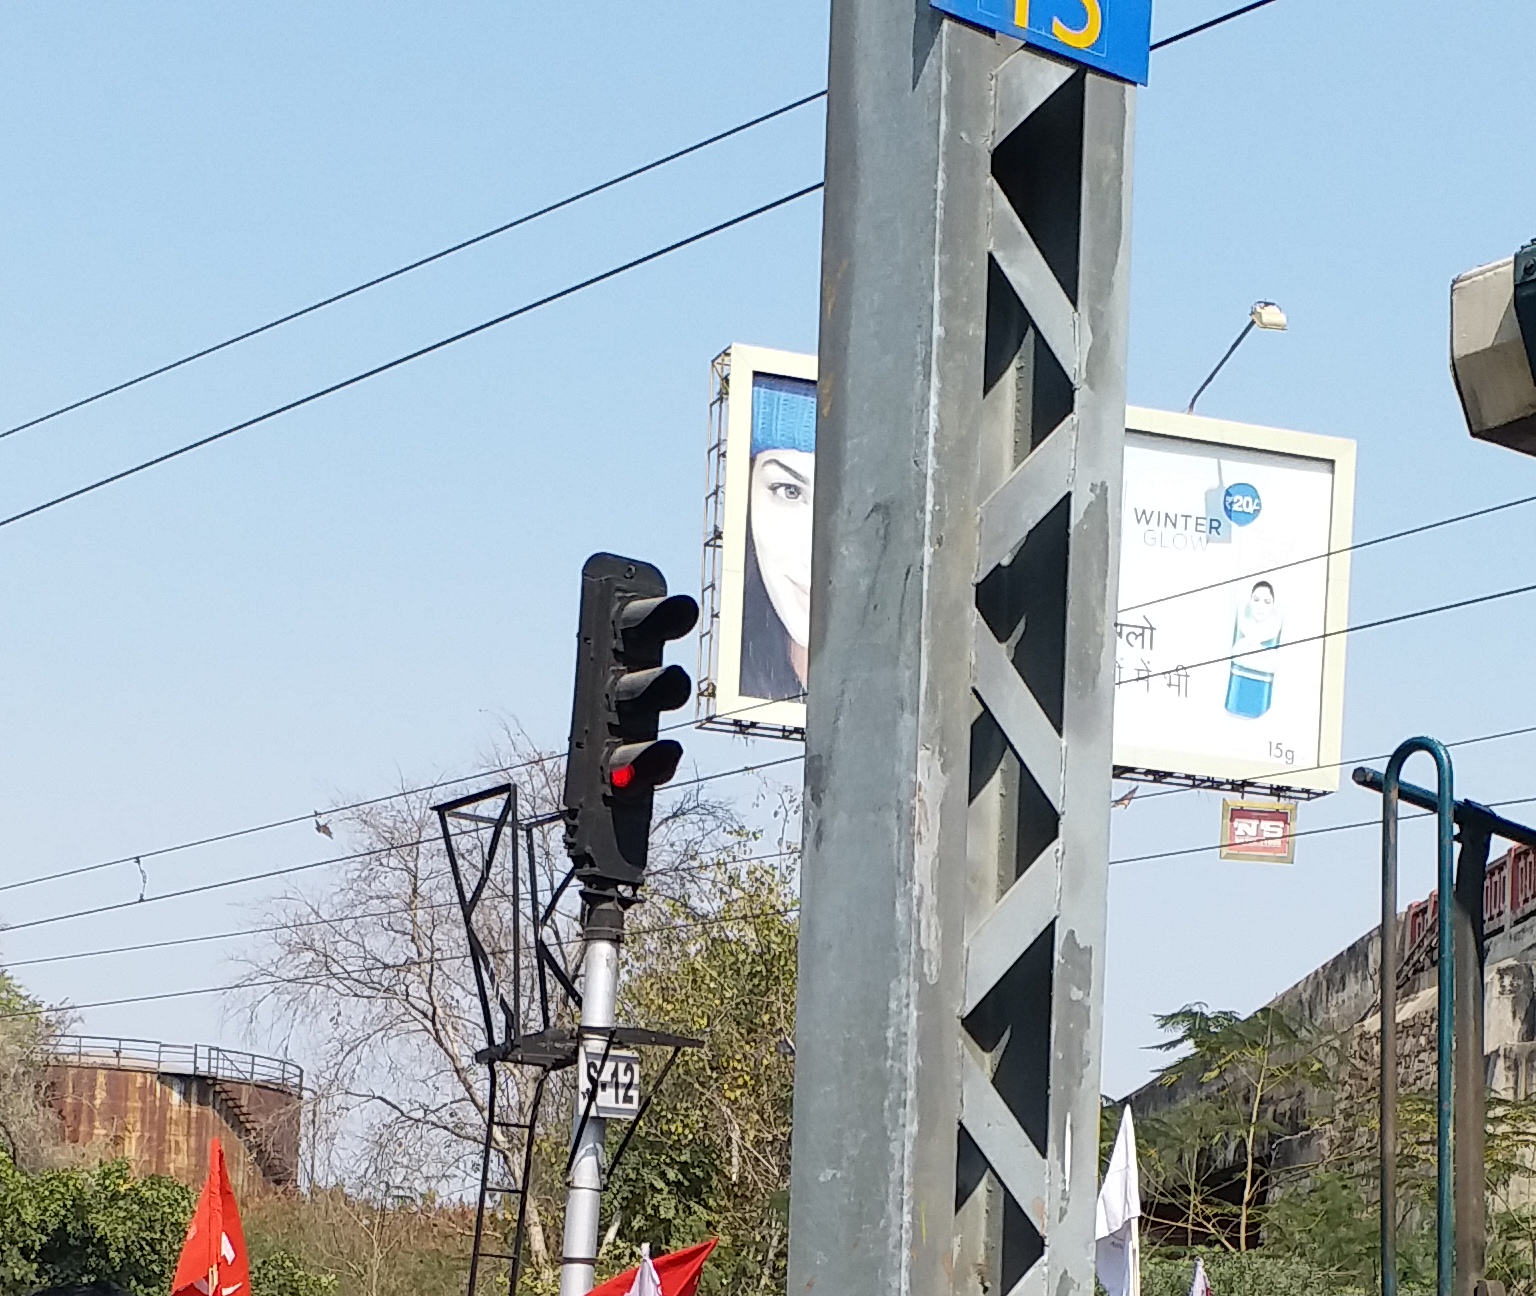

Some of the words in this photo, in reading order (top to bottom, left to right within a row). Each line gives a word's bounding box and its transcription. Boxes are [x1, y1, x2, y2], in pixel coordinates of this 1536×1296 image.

[1134, 507, 1222, 535] WINTER
[1143, 529, 1210, 551] GLOW
[1268, 740, 1295, 765] 15g
